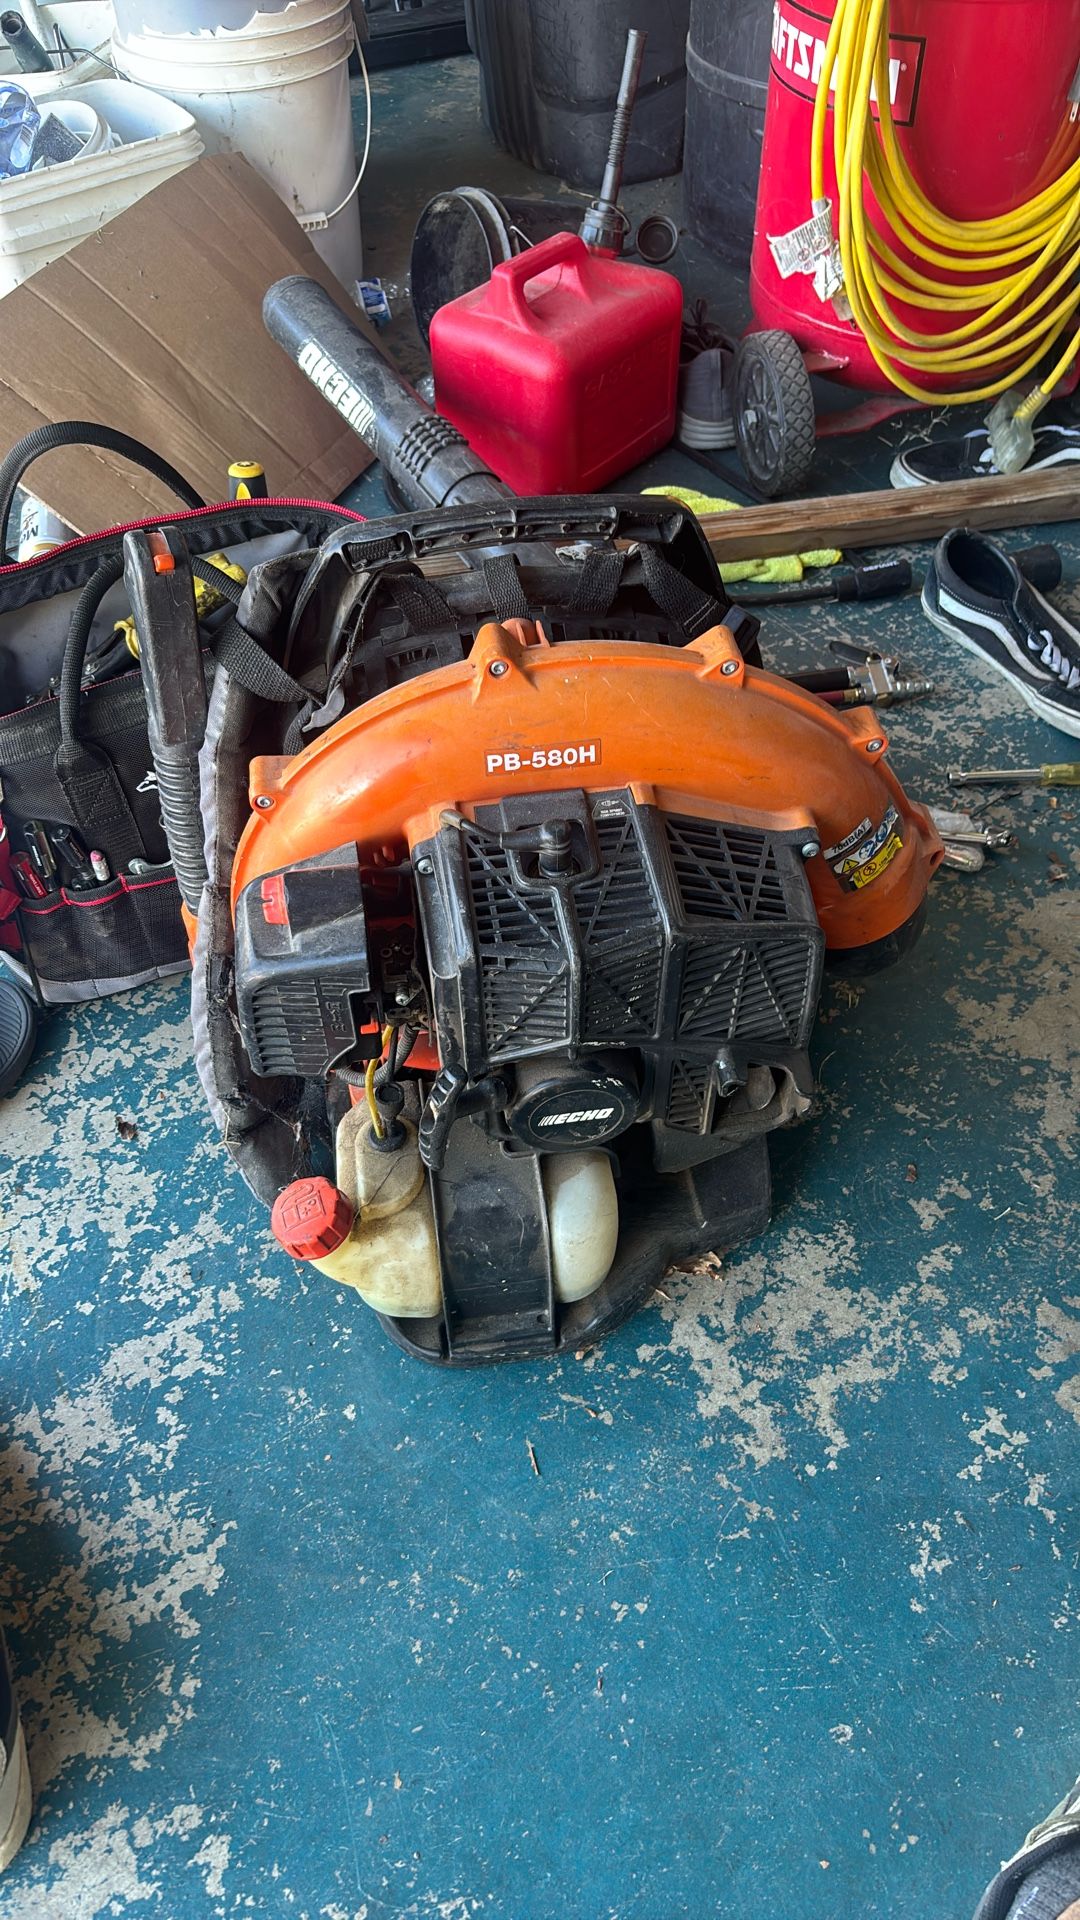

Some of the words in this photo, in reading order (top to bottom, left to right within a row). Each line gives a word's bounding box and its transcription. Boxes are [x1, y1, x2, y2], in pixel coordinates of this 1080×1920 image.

[298, 341, 366, 427] ECHO
[486, 744, 596, 773] PB-580H
[831, 824, 867, 854] 70dB(A)
[547, 1107, 615, 1126] ECHO
